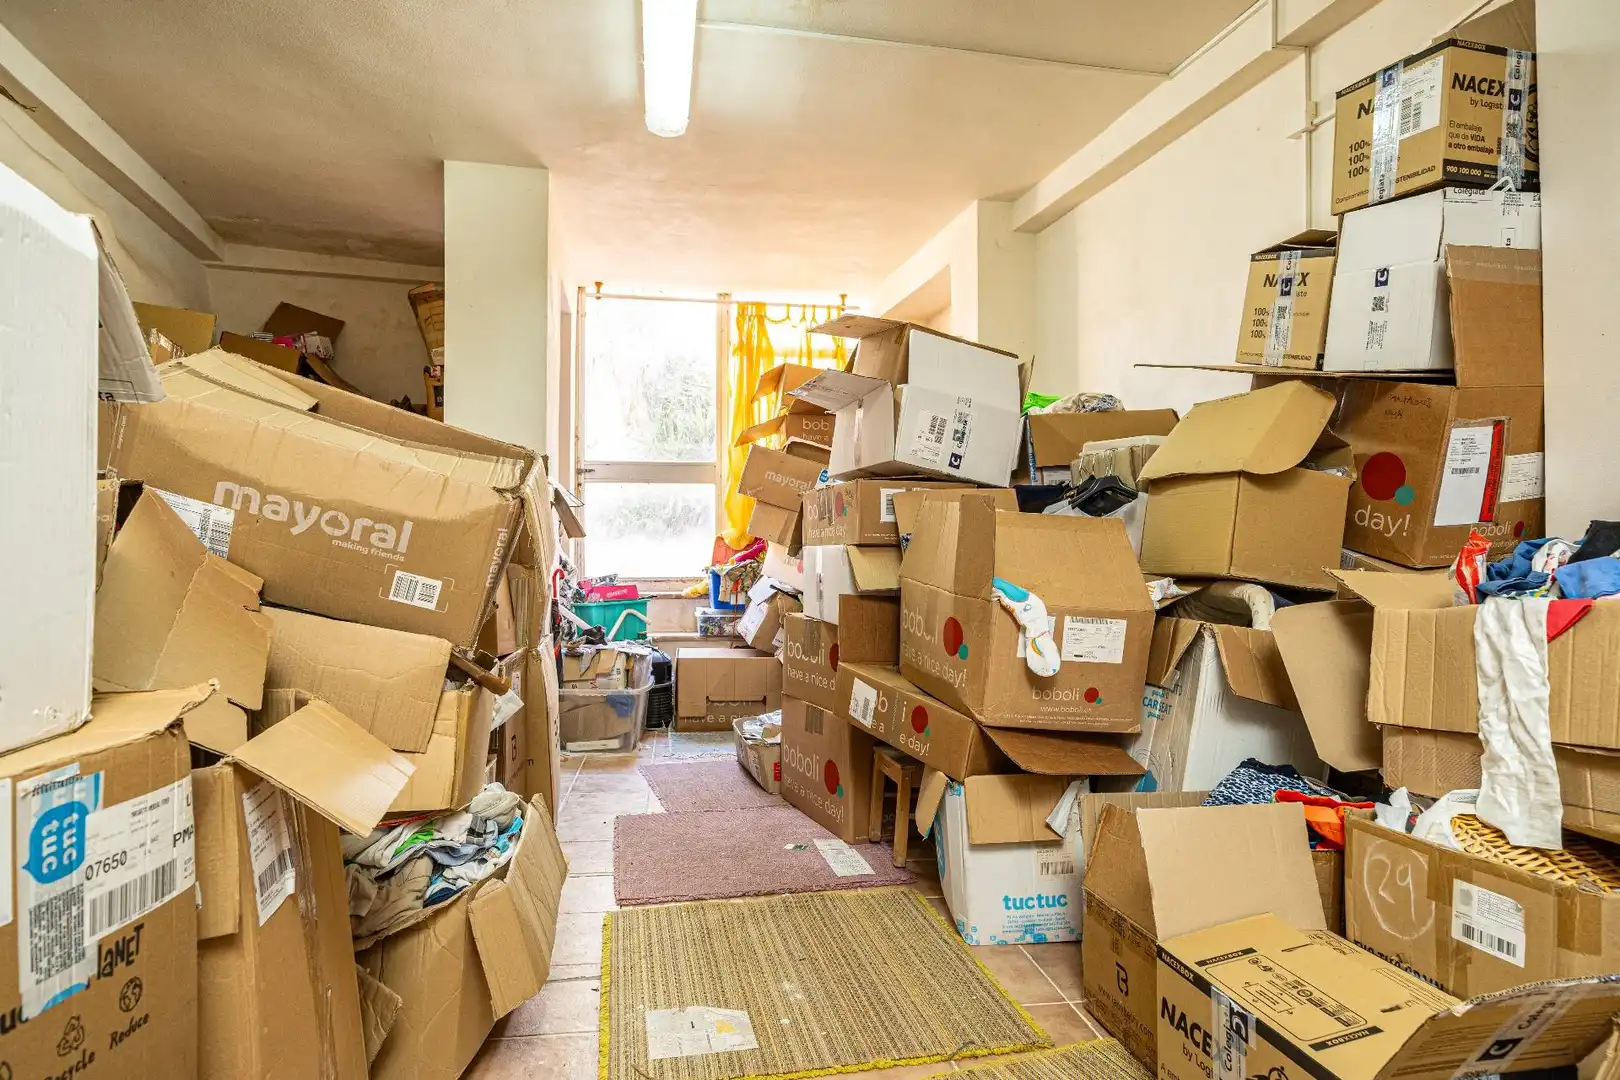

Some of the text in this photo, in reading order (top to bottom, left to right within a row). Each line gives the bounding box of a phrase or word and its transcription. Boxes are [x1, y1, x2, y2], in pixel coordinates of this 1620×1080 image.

[1452, 72, 1506, 97] NACEX
[1470, 97, 1506, 110] by Logist
[1448, 132, 1460, 140] que
[1470, 134, 1485, 143] VIDA
[1449, 120, 1483, 133] El embalaje
[1467, 145, 1495, 155] embalaje
[1446, 165, 1458, 173] 900
[764, 470, 812, 491] mayoral
[213, 481, 413, 553] mayoral
[1354, 504, 1411, 537] day!
[332, 538, 405, 562] making friends
[488, 527, 509, 588] mayoral
[787, 635, 825, 666] boli
[787, 664, 803, 681] have
[804, 671, 810, 683] a
[811, 672, 829, 689] nice
[941, 662, 968, 688] day!
[1032, 687, 1080, 701] boboli
[719, 715, 726, 723] a
[908, 736, 929, 757] day!
[783, 741, 819, 782] boboli
[824, 798, 844, 824] day!
[85, 850, 128, 881] 07650
[1003, 893, 1068, 911] tuctuc
[1367, 855, 1417, 924] 29
[1162, 952, 1194, 982] NACEXBOX
[1206, 951, 1243, 964] NACEXBOX
[110, 1013, 149, 1049] Reduce
[1161, 996, 1213, 1060] NACE
[1326, 1030, 1370, 1046] NACEXBOX
[1182, 1042, 1214, 1079] by Logi
